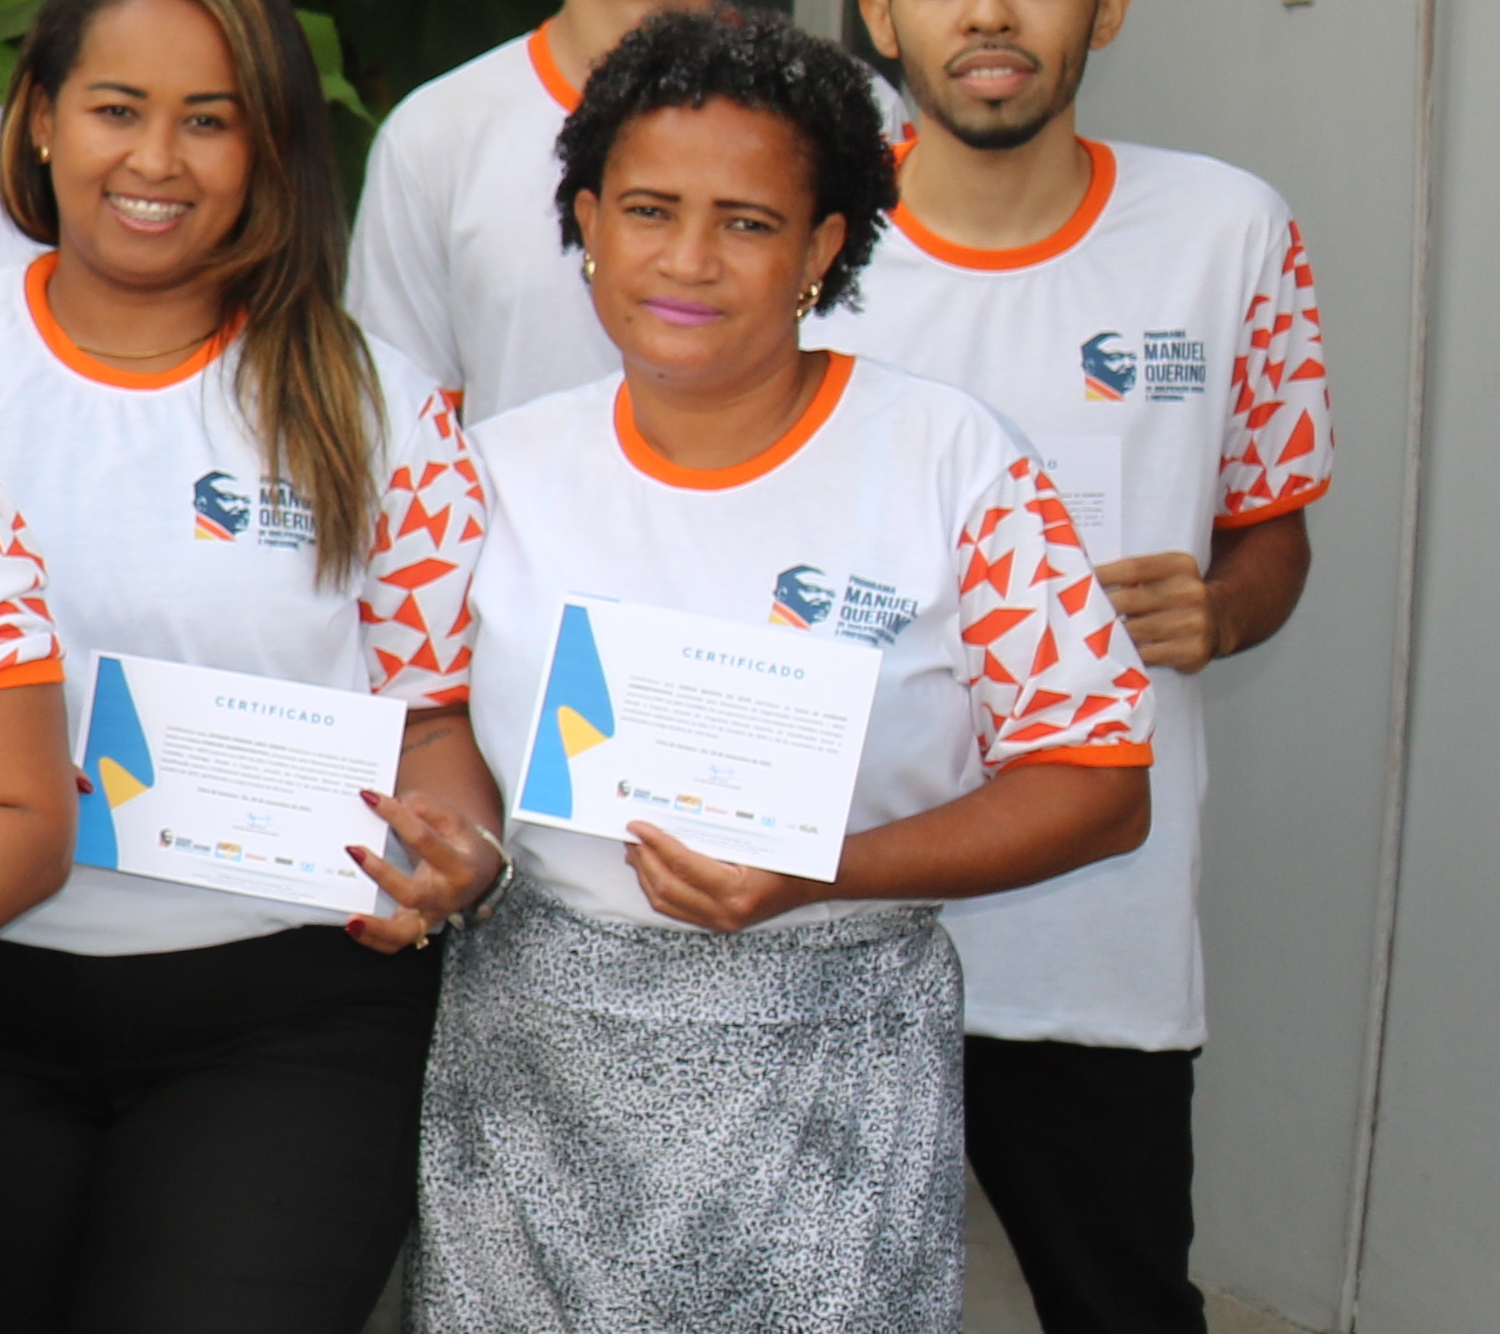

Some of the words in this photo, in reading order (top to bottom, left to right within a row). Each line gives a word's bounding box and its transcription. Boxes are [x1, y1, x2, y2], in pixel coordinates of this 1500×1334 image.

[1143, 341, 1207, 363] MANUEL
[1144, 362, 1207, 385] QUERINO
[842, 584, 920, 619] MANUEL
[681, 645, 807, 682] CERTIFICADO
[214, 694, 337, 728] CERTIFICADO
